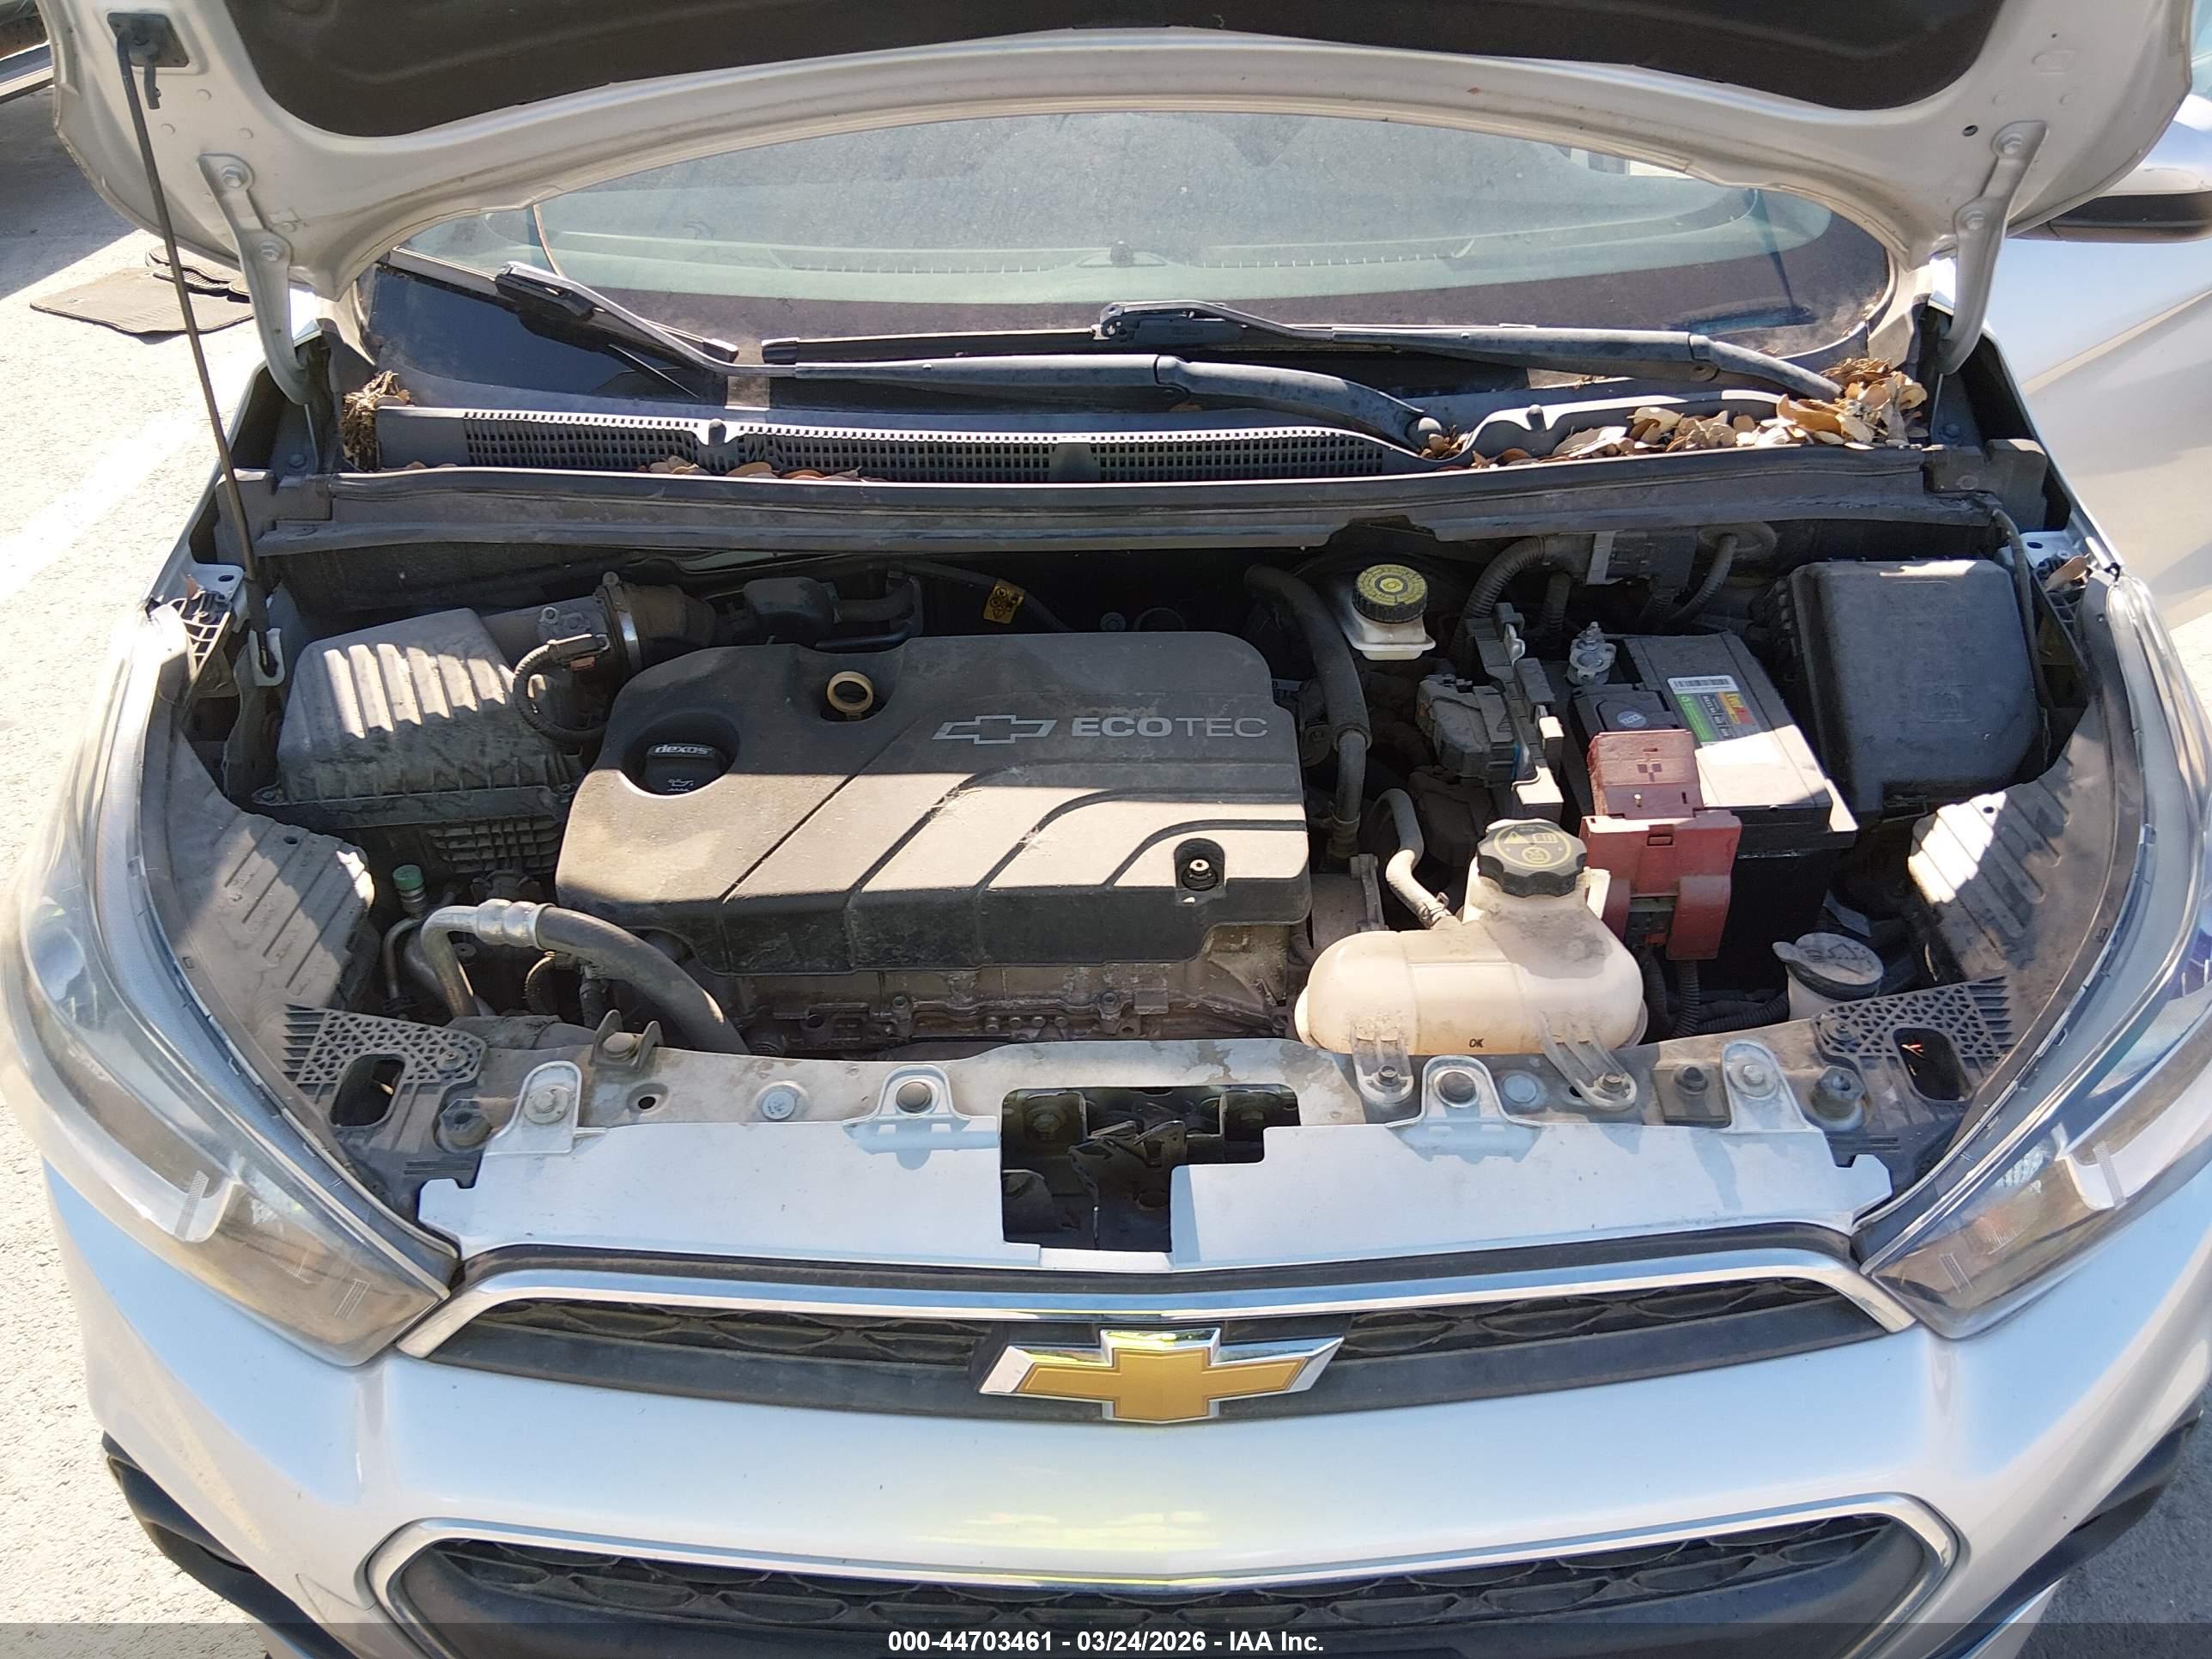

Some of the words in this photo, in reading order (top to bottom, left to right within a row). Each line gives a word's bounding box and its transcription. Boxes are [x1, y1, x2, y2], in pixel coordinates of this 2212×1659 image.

[1071, 717, 1268, 738] ECOTEC
[655, 744, 708, 754] dexos
[1469, 1038, 1485, 1048] OK
